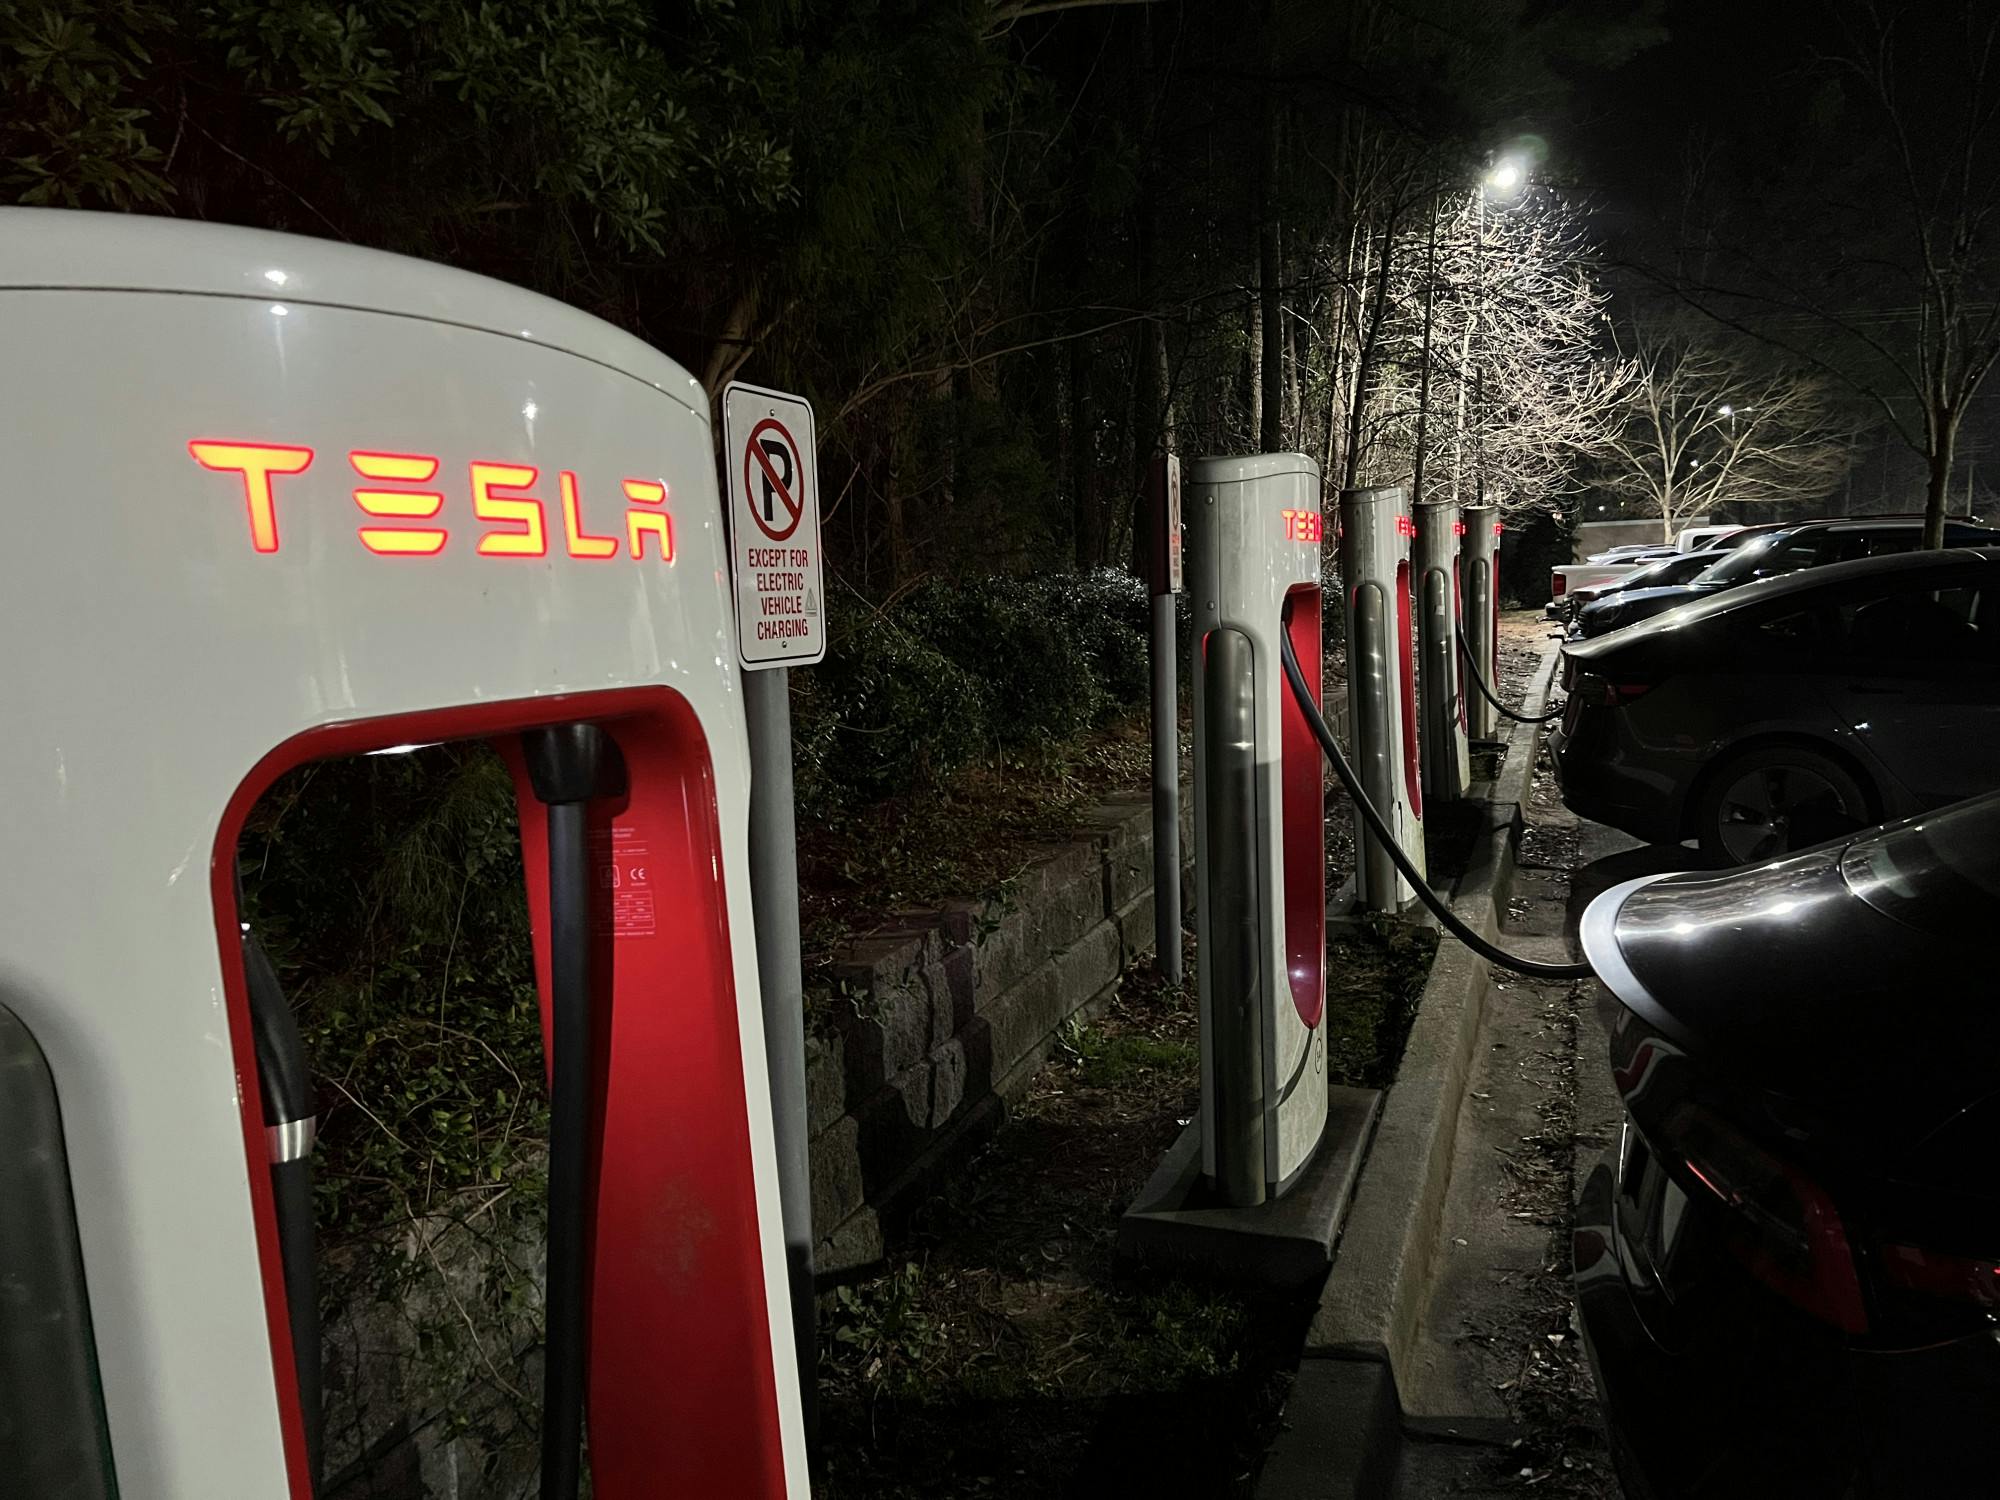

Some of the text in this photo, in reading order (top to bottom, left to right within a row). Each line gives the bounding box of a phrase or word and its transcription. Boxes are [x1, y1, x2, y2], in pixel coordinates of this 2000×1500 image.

[188, 440, 674, 562] TESLA
[748, 548, 809, 568] EXCEPT FOR
[756, 572, 804, 592] ELECTRIC
[760, 596, 802, 616] VEHICLE
[757, 618, 809, 640] CHARGING
